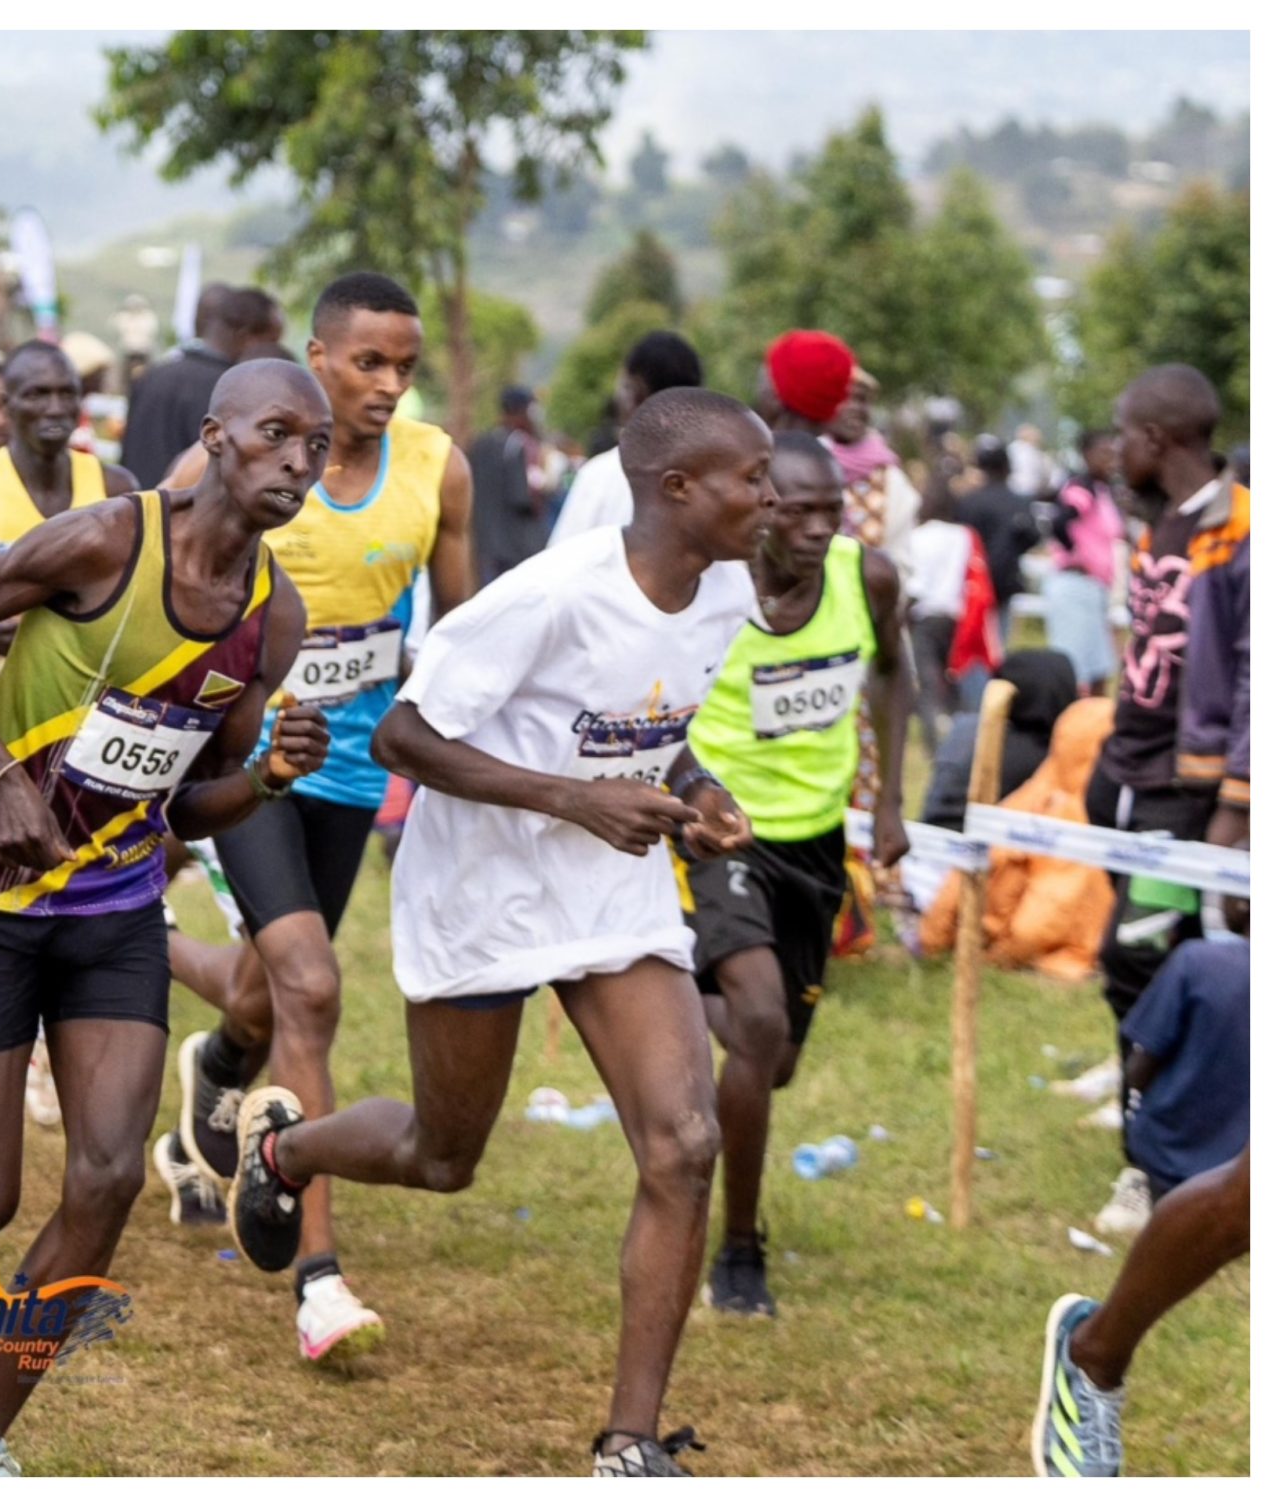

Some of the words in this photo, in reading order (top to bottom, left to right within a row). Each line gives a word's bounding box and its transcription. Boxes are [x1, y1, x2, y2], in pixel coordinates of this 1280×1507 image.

[303, 650, 375, 685] 0282
[773, 684, 844, 716] 0500
[100, 736, 180, 777] 0558
